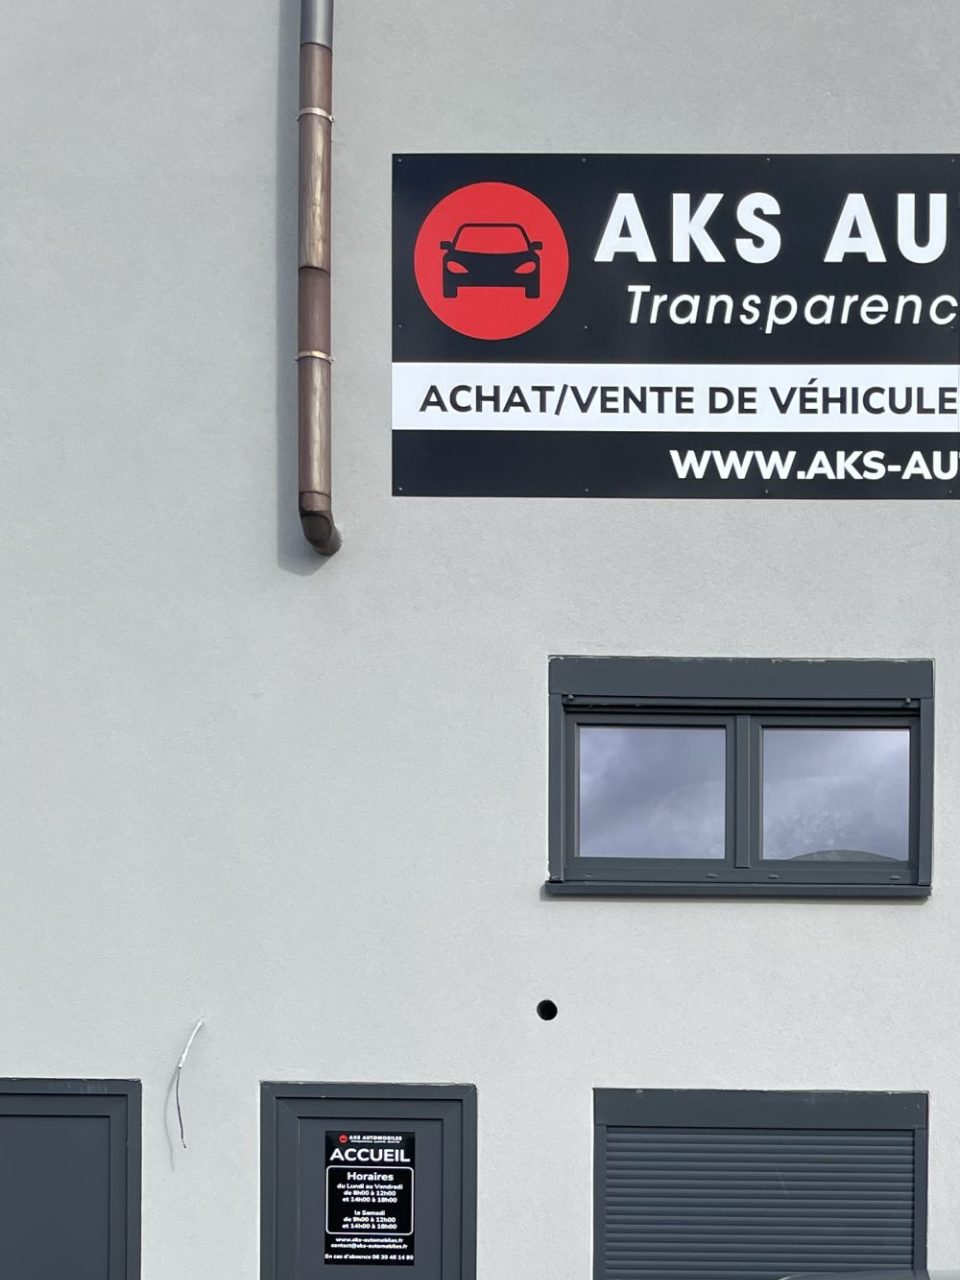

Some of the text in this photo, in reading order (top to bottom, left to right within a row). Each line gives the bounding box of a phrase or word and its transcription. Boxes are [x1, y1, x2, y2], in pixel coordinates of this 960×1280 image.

[594, 191, 781, 264] AKS
[419, 383, 694, 416] ACHAT/VENTE
[708, 386, 757, 414] DE
[329, 1147, 411, 1163] ACCUEIL
[347, 1171, 394, 1182] Horaires
